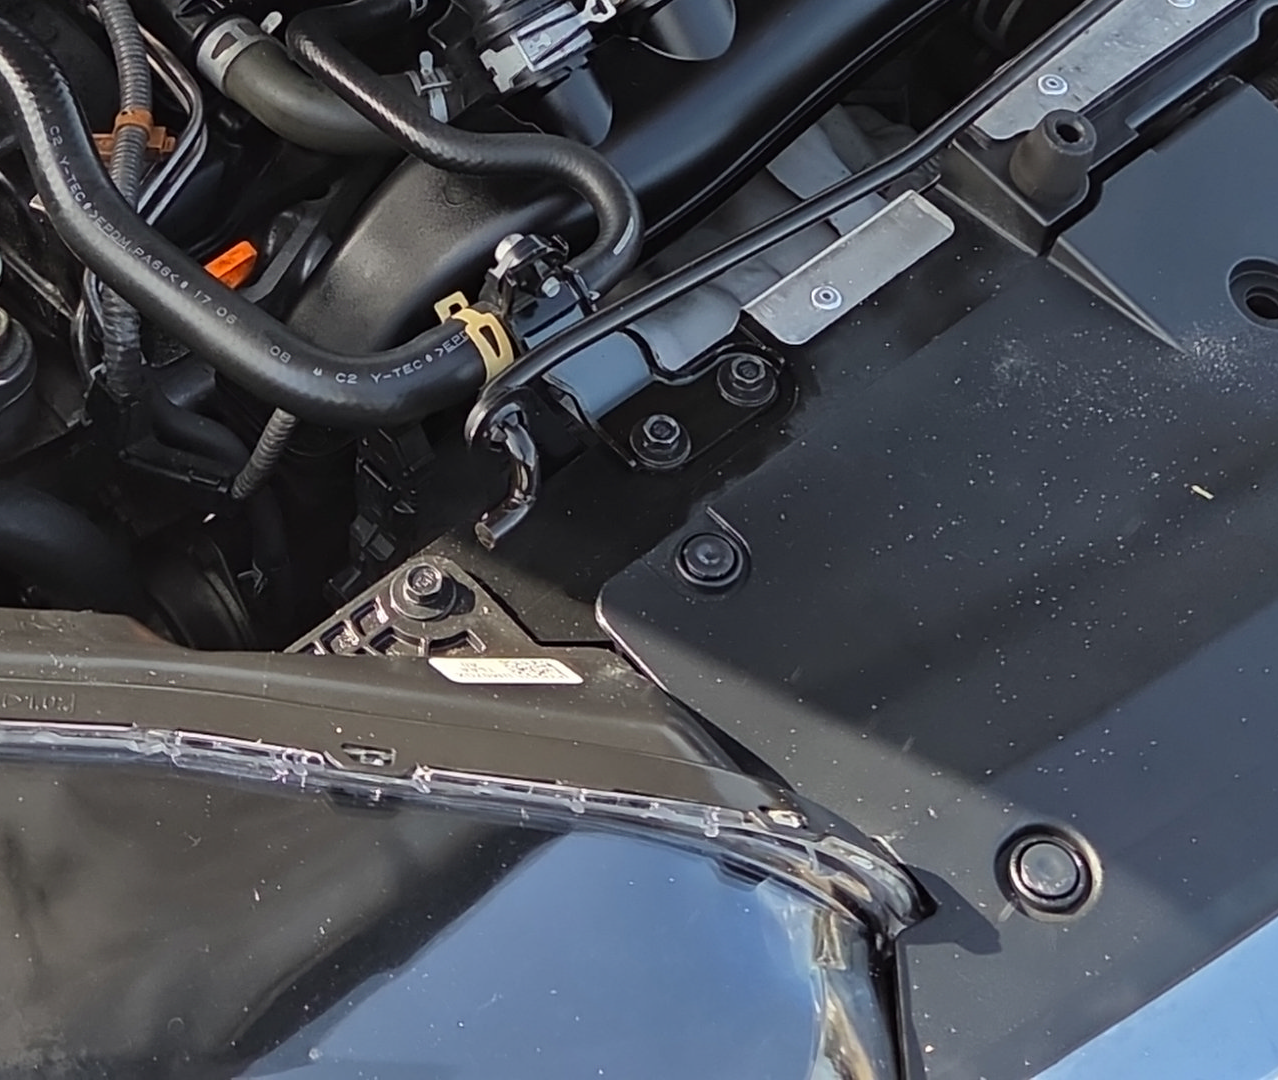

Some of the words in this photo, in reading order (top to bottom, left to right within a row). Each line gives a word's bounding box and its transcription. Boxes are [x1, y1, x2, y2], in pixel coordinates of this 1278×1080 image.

[49, 125, 64, 146] C2
[193, 290, 212, 305] 17
[216, 306, 238, 325] 06
[335, 372, 358, 384] C2
